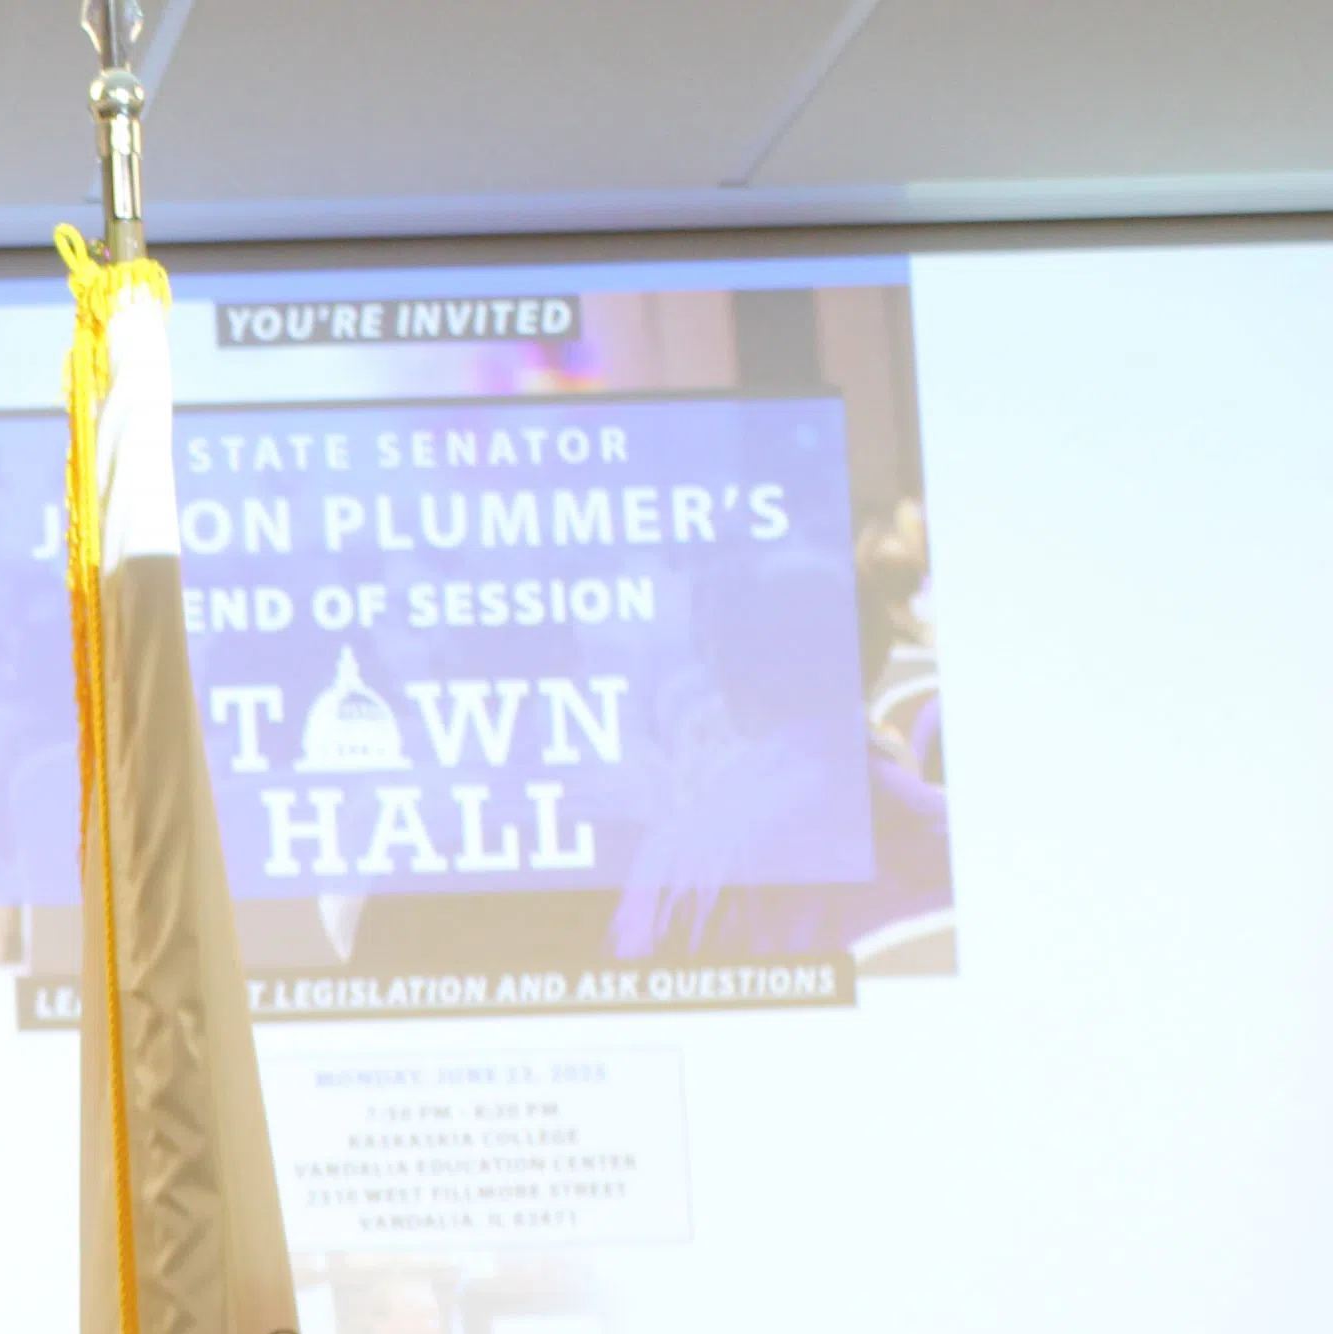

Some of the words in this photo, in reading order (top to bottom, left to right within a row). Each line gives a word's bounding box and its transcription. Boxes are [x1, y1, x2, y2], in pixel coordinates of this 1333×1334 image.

[225, 305, 383, 343] YOU'RE
[396, 300, 574, 339] INVITED
[186, 433, 353, 475] STATE
[376, 426, 632, 468] SENATOR
[32, 497, 293, 560] JON
[323, 484, 791, 553] PLUMMER'S
[184, 586, 294, 633] END
[311, 584, 389, 630] OF
[407, 576, 657, 628] SESSION
[259, 780, 596, 878] HALL
[275, 973, 491, 1007] LEGISLATION
[495, 971, 563, 1002] AND
[572, 968, 641, 1000] ASK
[648, 964, 836, 1000] QUESTIONS
